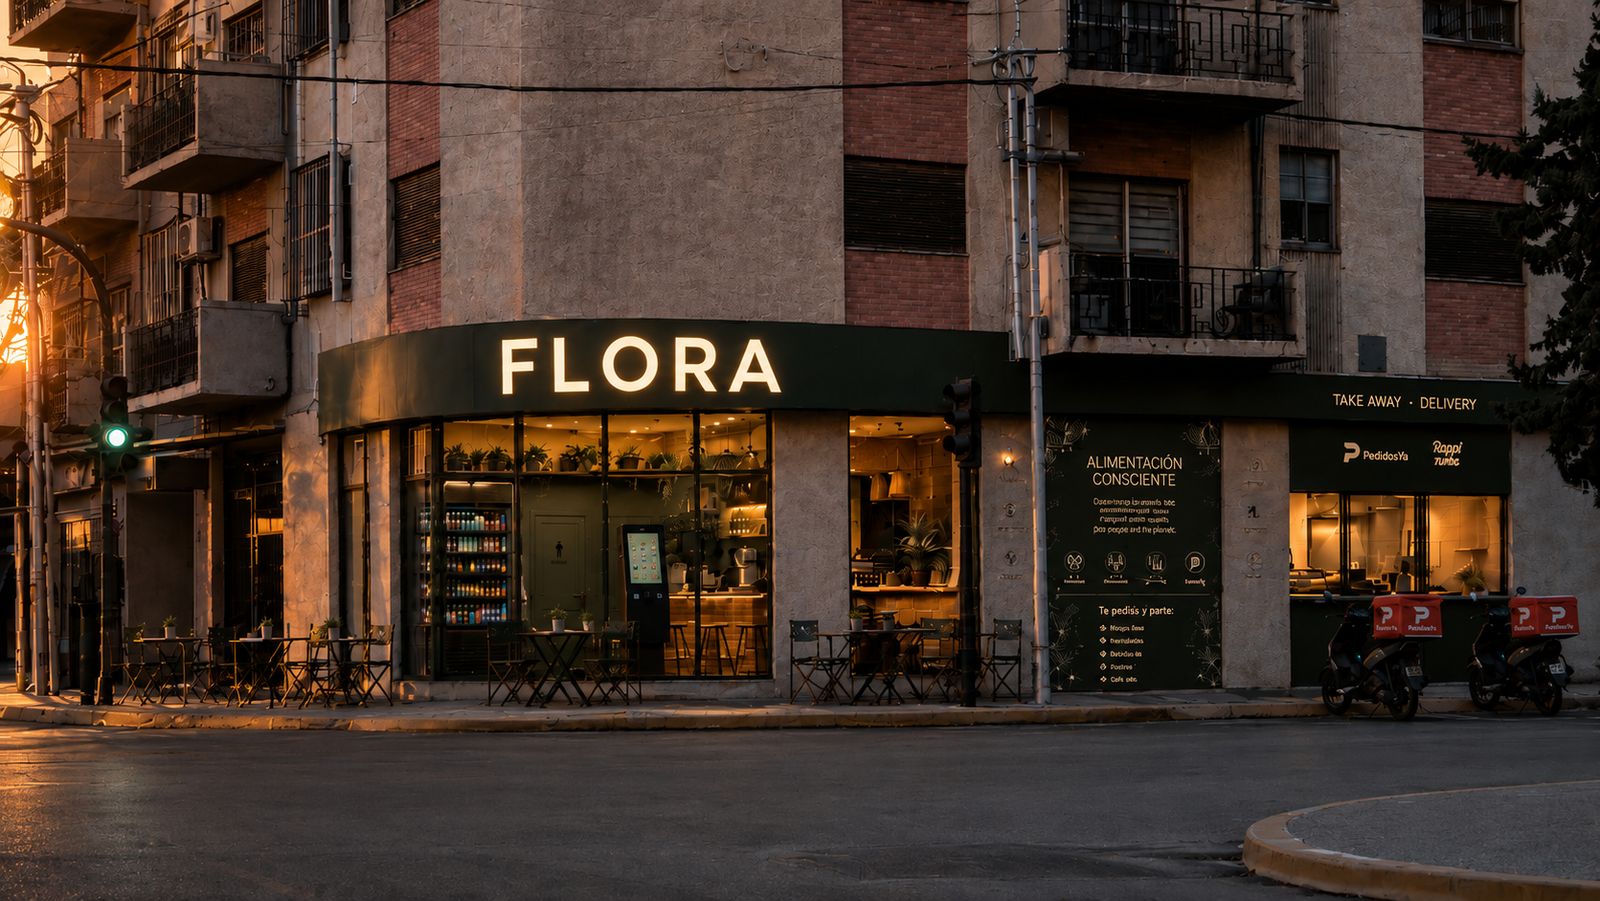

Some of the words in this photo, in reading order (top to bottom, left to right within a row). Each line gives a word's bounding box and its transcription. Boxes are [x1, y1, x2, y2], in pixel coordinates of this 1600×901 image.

[501, 335, 782, 395] FLORA
[1332, 393, 1364, 407] TAKE
[1367, 395, 1402, 408] AWAY
[1420, 396, 1477, 411] DELIVERY
[1363, 450, 1409, 462] PedidosYa
[1432, 440, 1463, 457] Rappi
[1086, 454, 1183, 470] ALIMENTACIÓN
[1092, 472, 1176, 487] CONSCIENTE
[1098, 606, 1109, 615] Te
[1141, 608, 1148, 617] y
[1149, 607, 1175, 617] parte:
